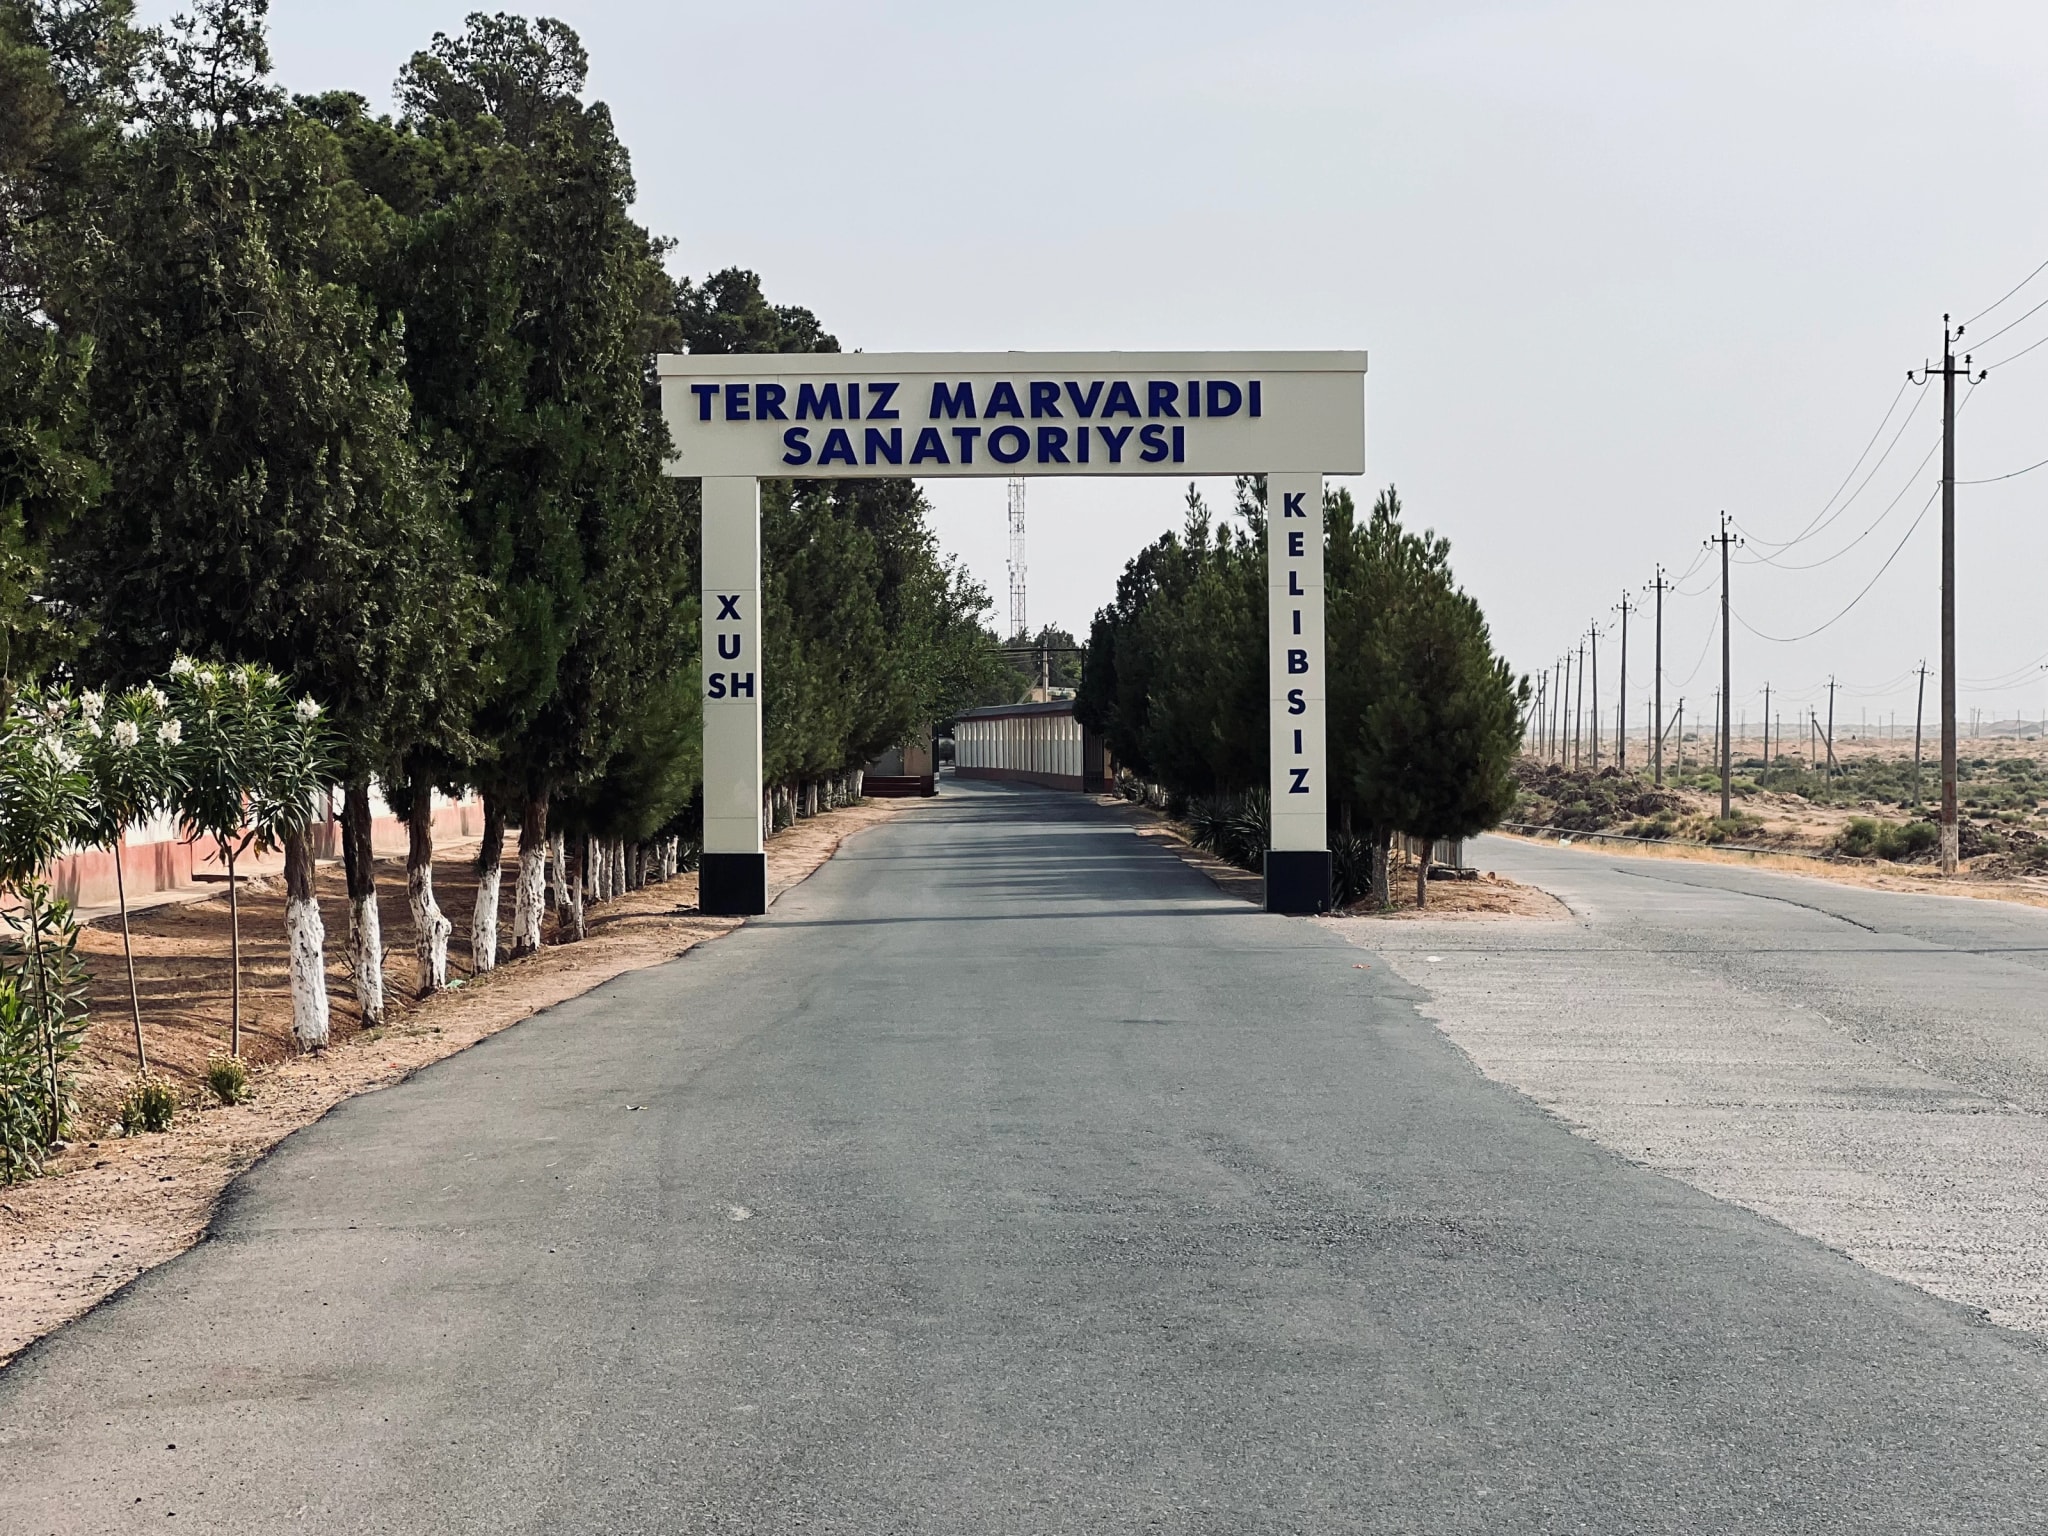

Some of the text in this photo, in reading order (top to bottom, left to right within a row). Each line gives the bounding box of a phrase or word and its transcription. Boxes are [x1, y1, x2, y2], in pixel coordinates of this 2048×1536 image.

[690, 380, 1262, 421] TERMIZ MARVARIDI
[782, 424, 1186, 466] SANATORIYSI
[707, 594, 755, 699] XUSH
[1283, 492, 1310, 794] KELIBSIZ
